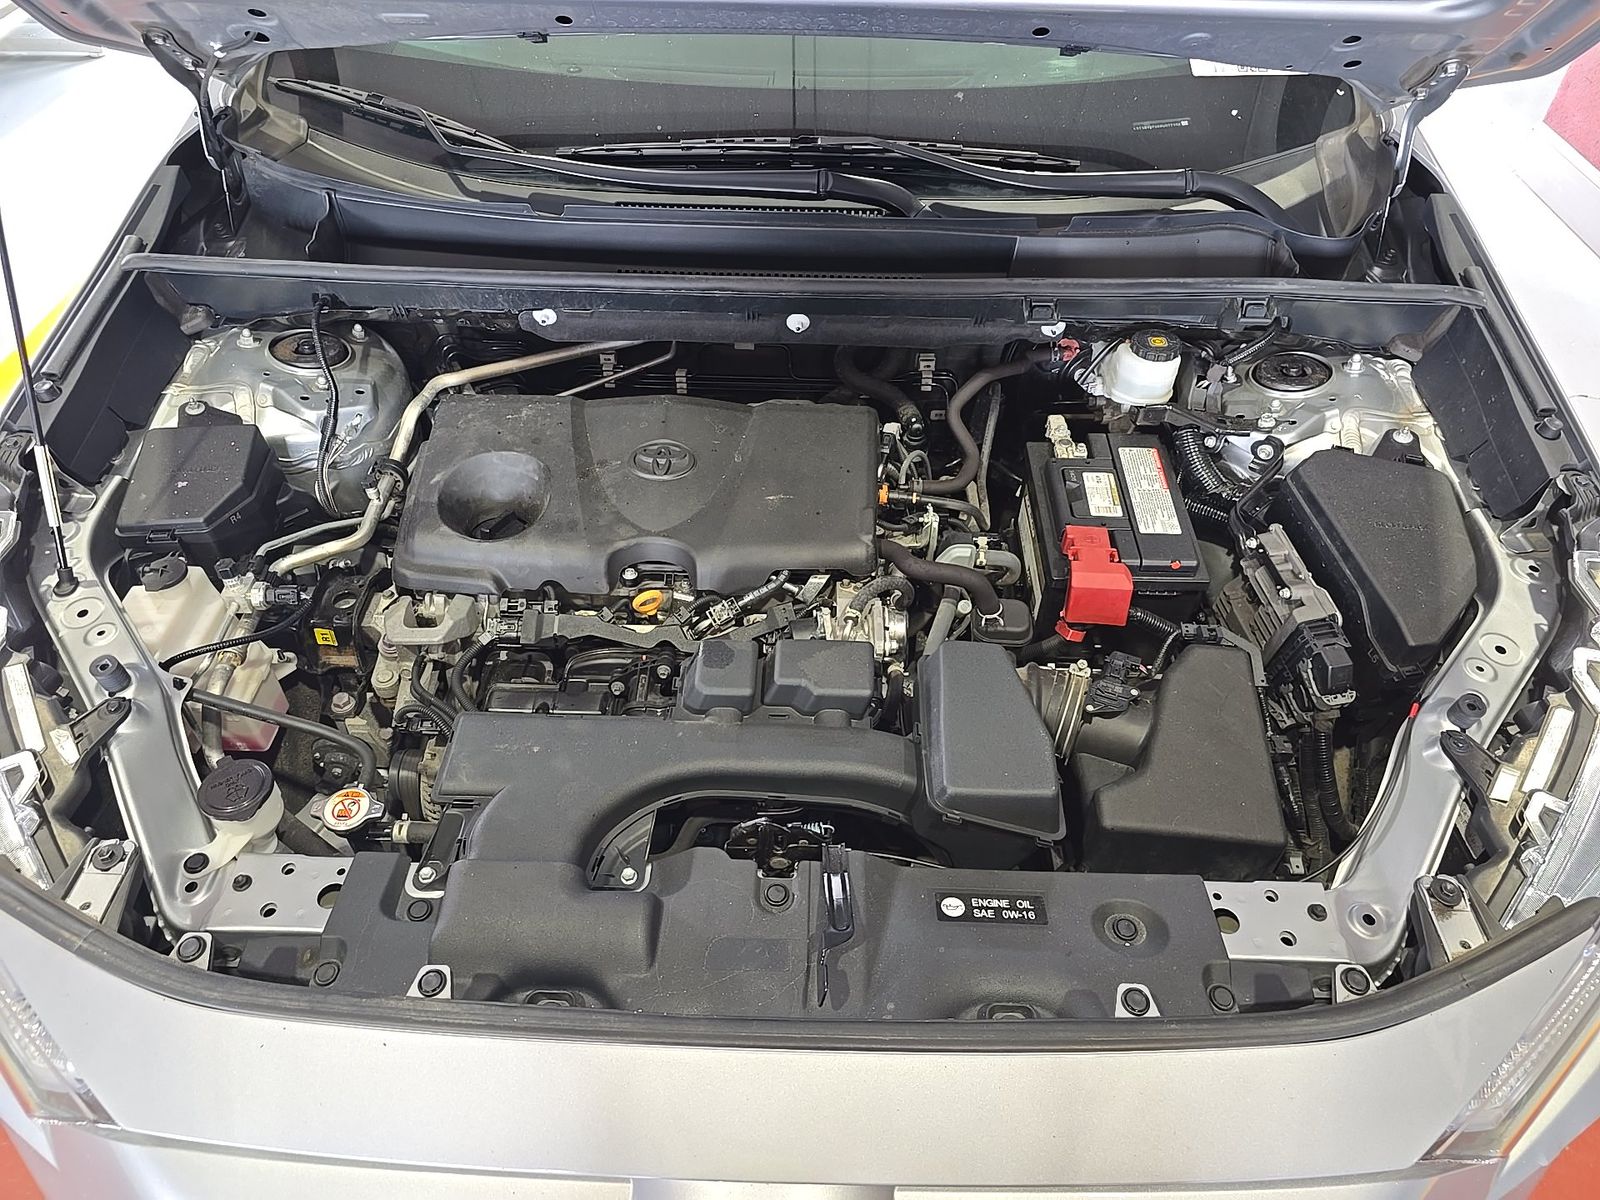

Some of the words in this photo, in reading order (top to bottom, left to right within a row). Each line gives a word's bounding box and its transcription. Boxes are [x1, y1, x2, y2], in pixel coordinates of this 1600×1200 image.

[229, 511, 242, 525] R4
[971, 898, 1011, 908] ENGINE
[1016, 900, 1035, 909] OIL
[973, 908, 995, 919] SAE
[1002, 910, 1036, 920] 0W-16
